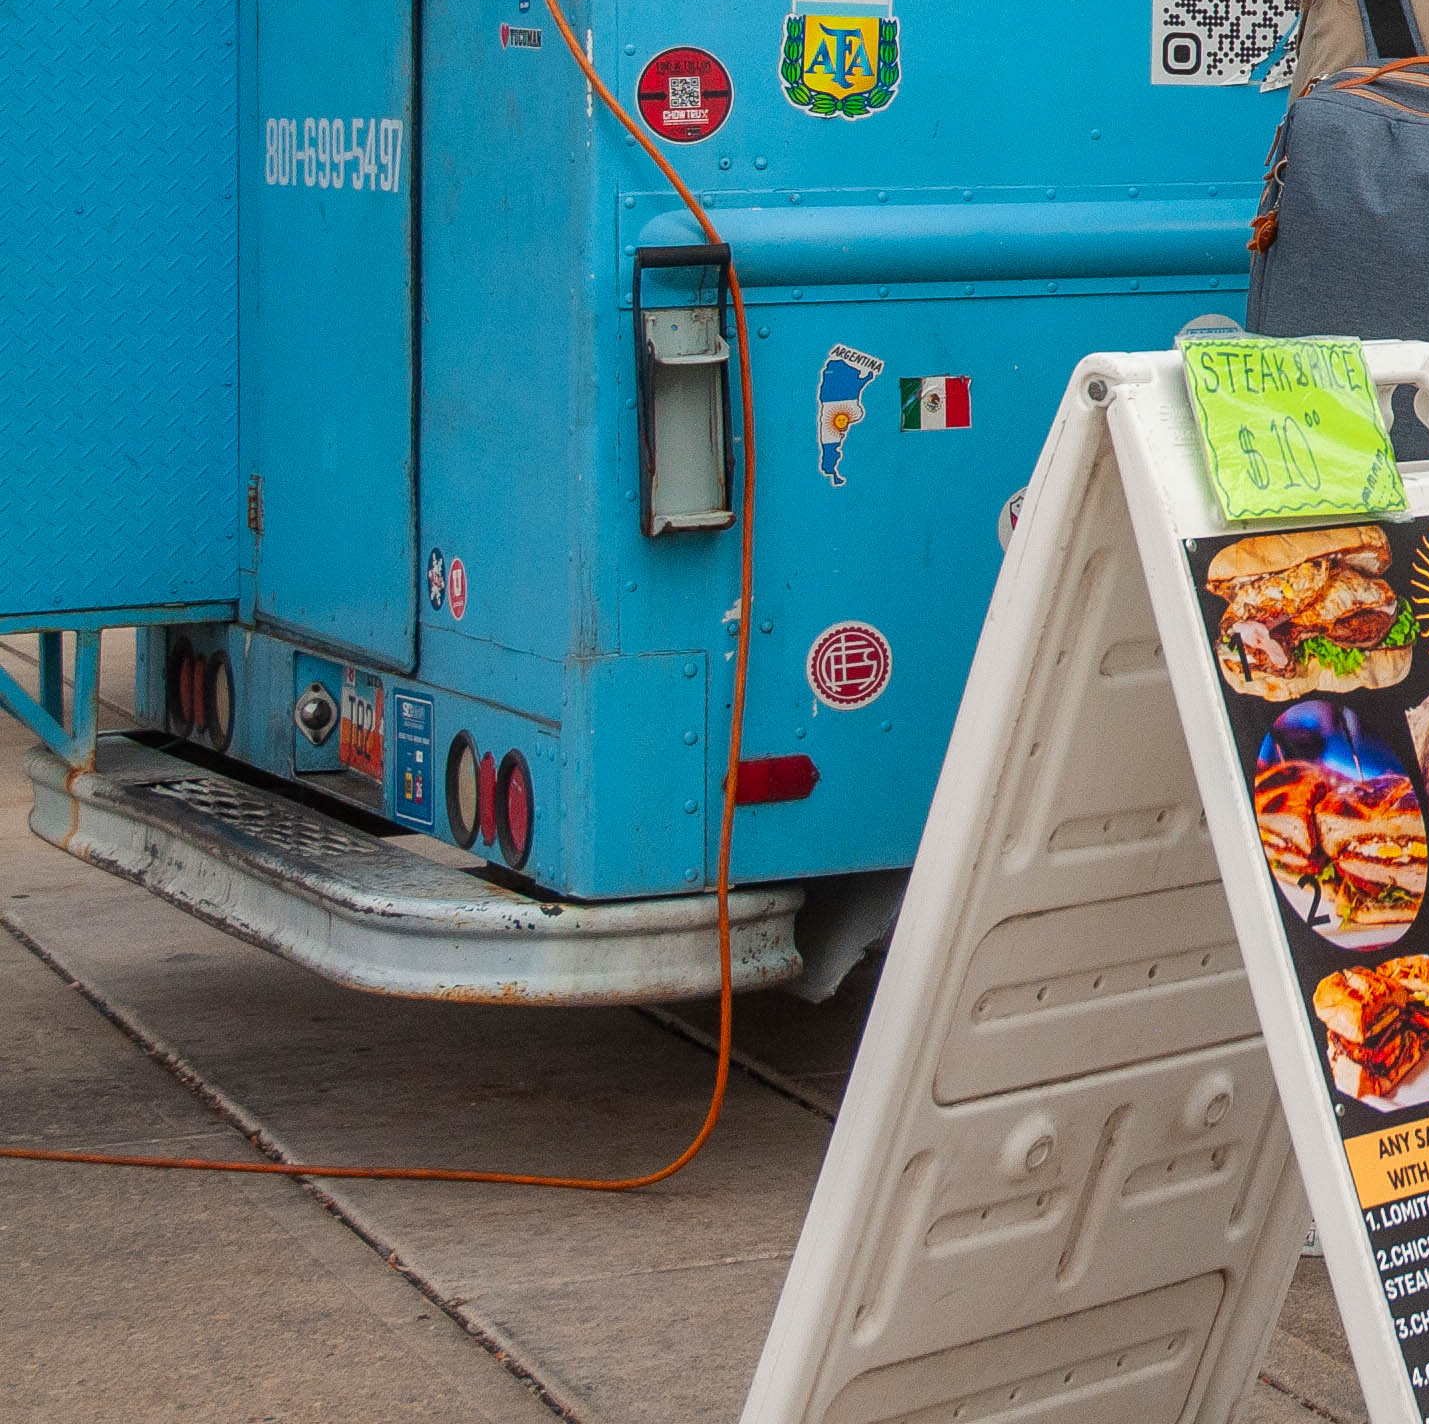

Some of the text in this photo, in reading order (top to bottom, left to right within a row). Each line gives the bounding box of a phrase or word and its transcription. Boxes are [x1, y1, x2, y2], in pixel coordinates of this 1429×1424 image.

[805, 22, 876, 89] AFA
[662, 109, 686, 121] CHOW
[266, 117, 404, 193] 801-699-5497
[830, 345, 883, 374] ARGENTINA
[1200, 351, 1293, 394] STEAK
[1305, 344, 1363, 392] RICE
[1238, 415, 1321, 491] $10
[1233, 632, 1251, 683] 1
[1297, 874, 1331, 926] 2
[1378, 1132, 1411, 1160] ANY
[1386, 1161, 1429, 1191] WITH
